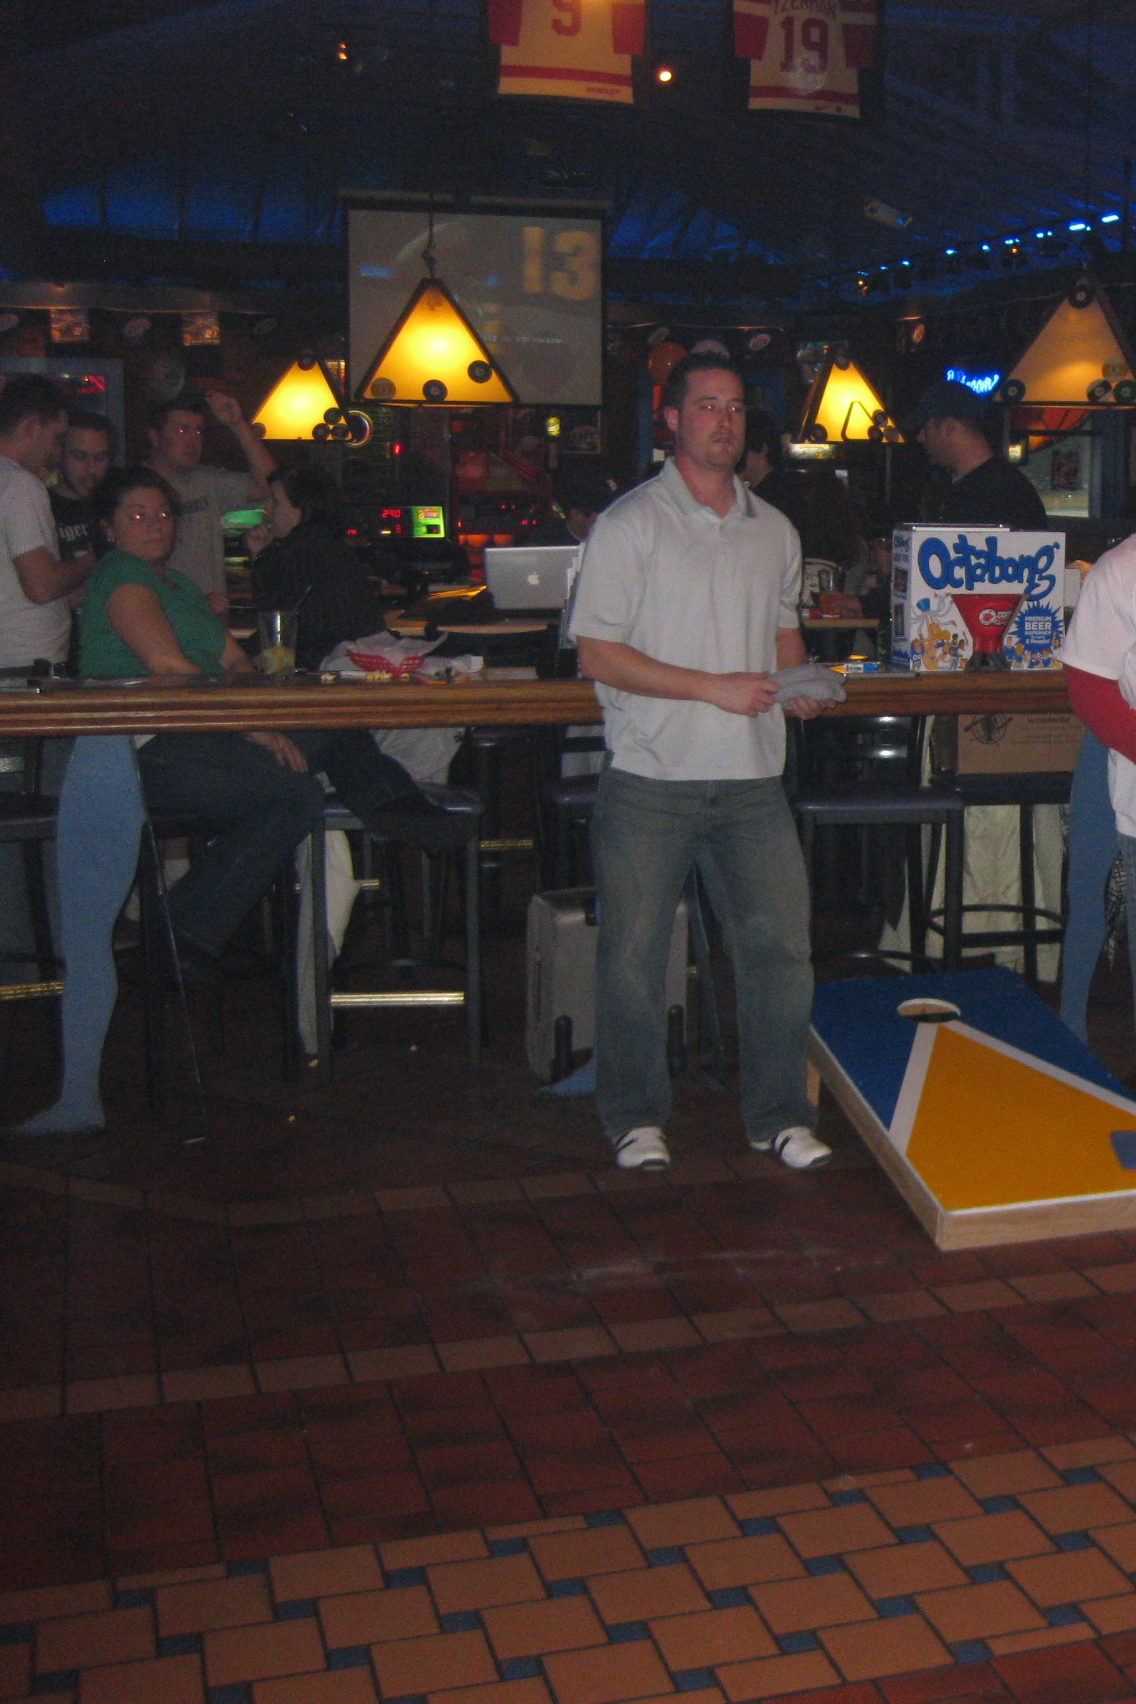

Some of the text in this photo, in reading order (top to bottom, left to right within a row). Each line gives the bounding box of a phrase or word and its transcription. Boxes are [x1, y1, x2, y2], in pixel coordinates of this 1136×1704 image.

[780, 16, 828, 74] 19
[522, 226, 599, 300] 13
[58, 522, 89, 542] iger
[918, 534, 1060, 601] Octabong
[1025, 622, 1052, 630] BEER
